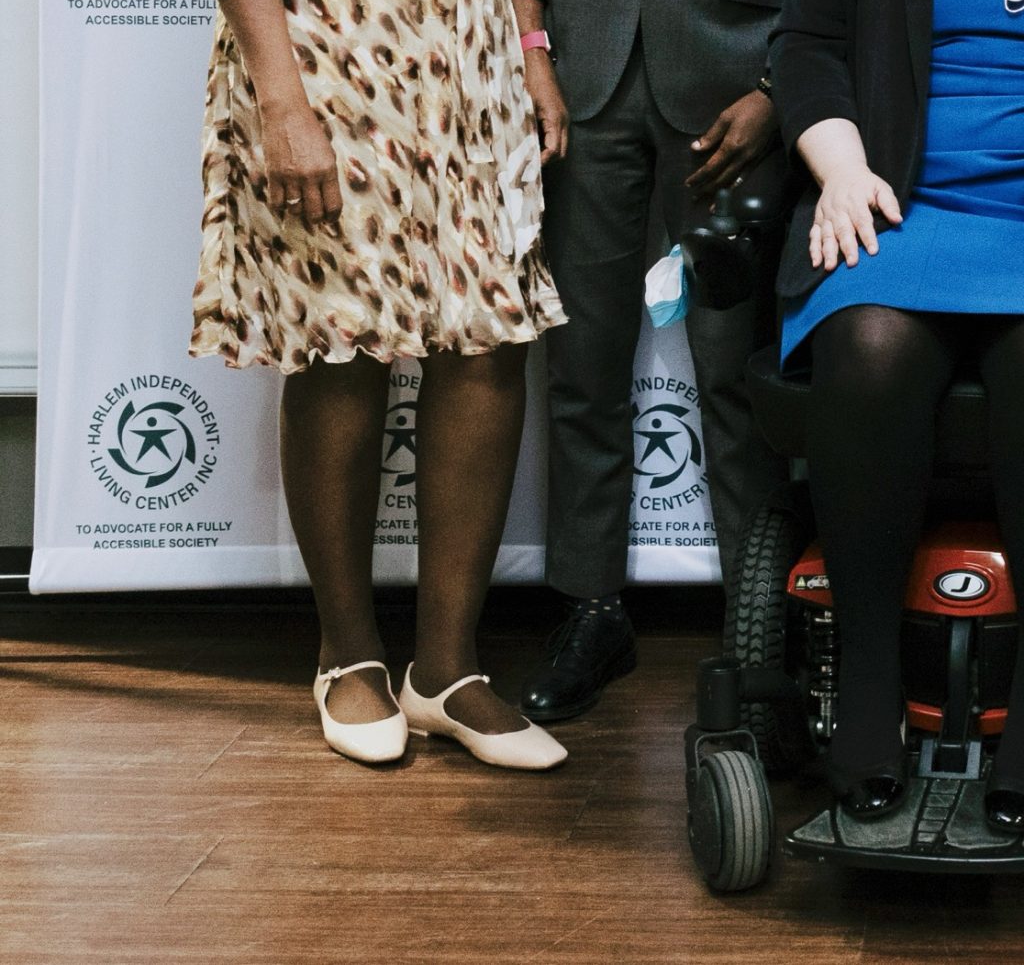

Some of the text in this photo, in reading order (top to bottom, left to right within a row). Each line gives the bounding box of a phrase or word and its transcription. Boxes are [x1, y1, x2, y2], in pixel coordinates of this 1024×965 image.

[87, 0, 150, 9] ADVOCATE
[152, 0, 176, 9] FOR
[179, 0, 189, 9] A
[85, 14, 212, 26] ACCESSIBLE SOCIETY
[88, 375, 220, 444] HARLEM INDEPENDENT
[90, 457, 131, 504] LIVING
[136, 483, 199, 510] CENTER
[640, 483, 704, 512] CENTER
[75, 521, 232, 535] TO ADVOCATE FOR A FULLY
[666, 521, 701, 532] FOR A
[92, 537, 218, 549] ACCESSIBLE SOCIETY
[950, 576, 972, 593] J
